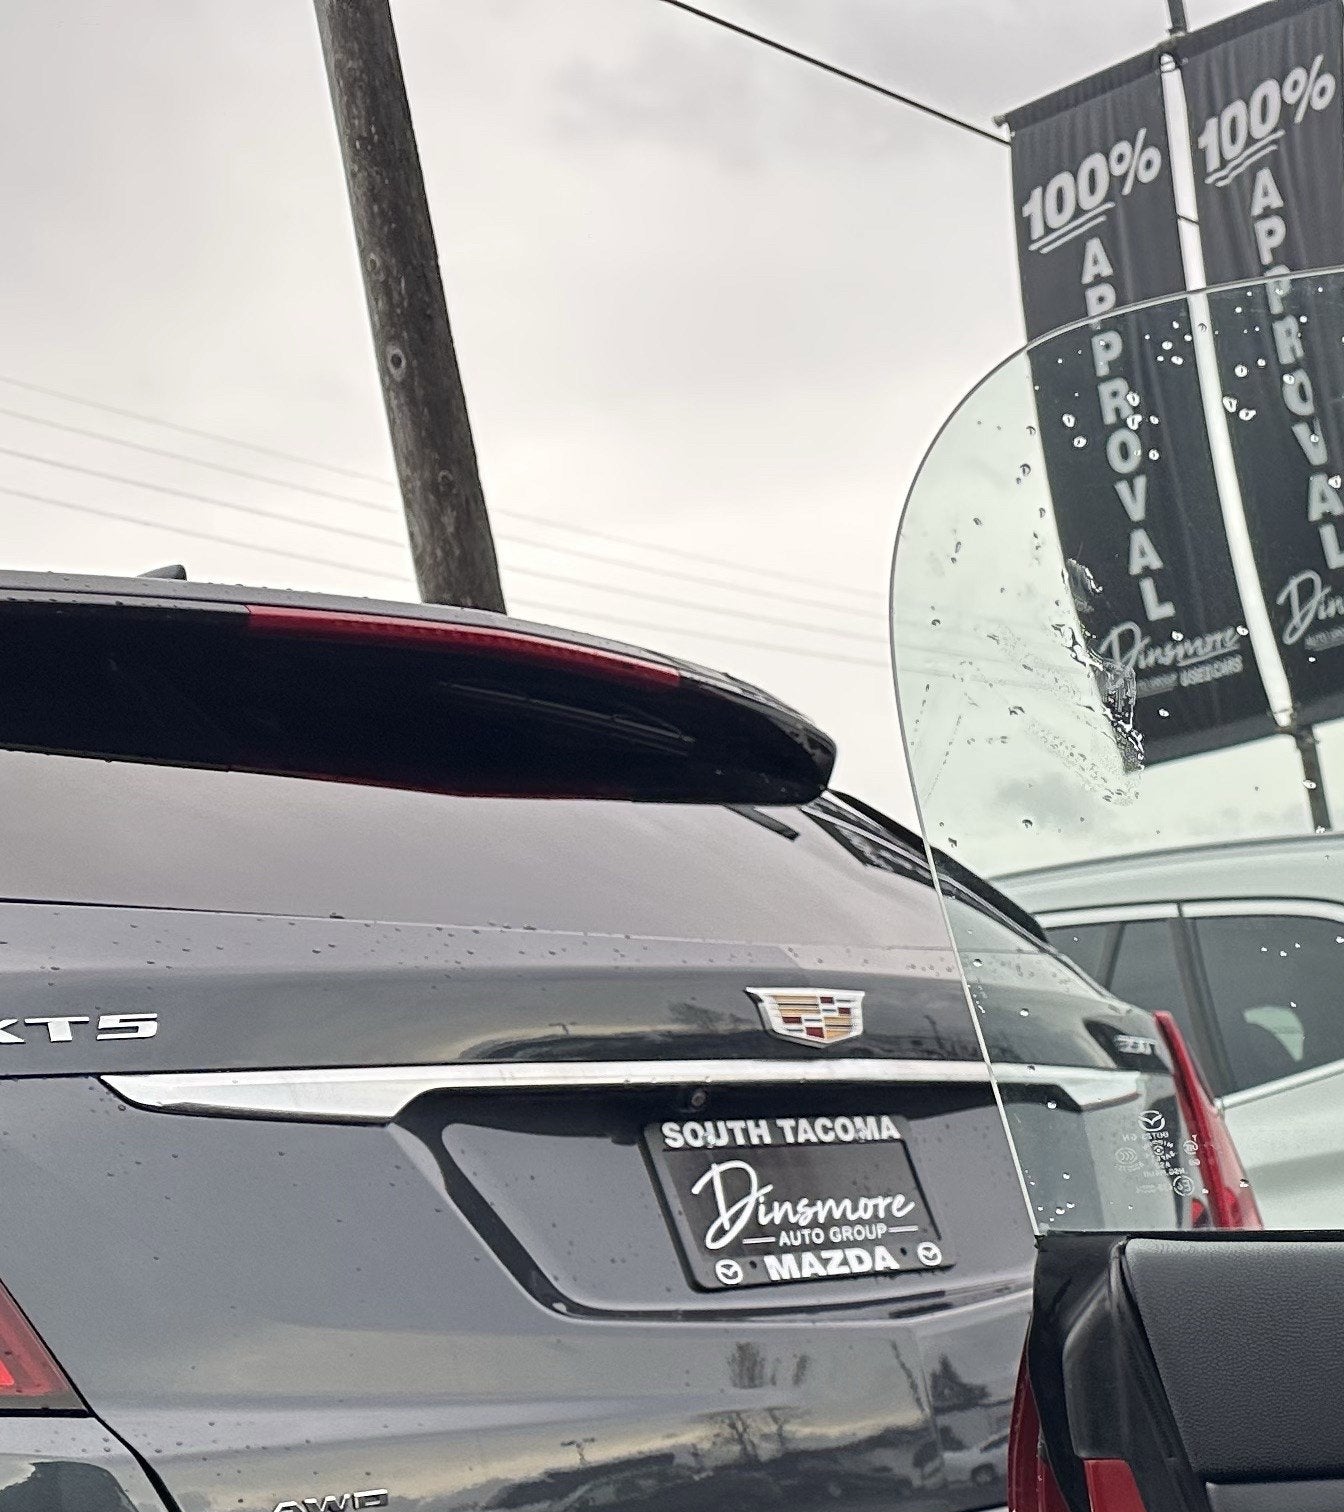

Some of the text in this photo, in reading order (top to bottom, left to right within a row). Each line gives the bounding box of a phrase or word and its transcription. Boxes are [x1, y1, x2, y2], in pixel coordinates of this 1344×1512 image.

[1196, 53, 1336, 176] 100%
[1022, 127, 1162, 240] 100%
[1081, 236, 1175, 622] APPROVAL
[661, 1115, 901, 1148] SOUTH TACOMA
[691, 1159, 915, 1250] Dinsmore
[779, 1223, 888, 1246] AUTO GROUP
[763, 1245, 900, 1281] MAZDA
